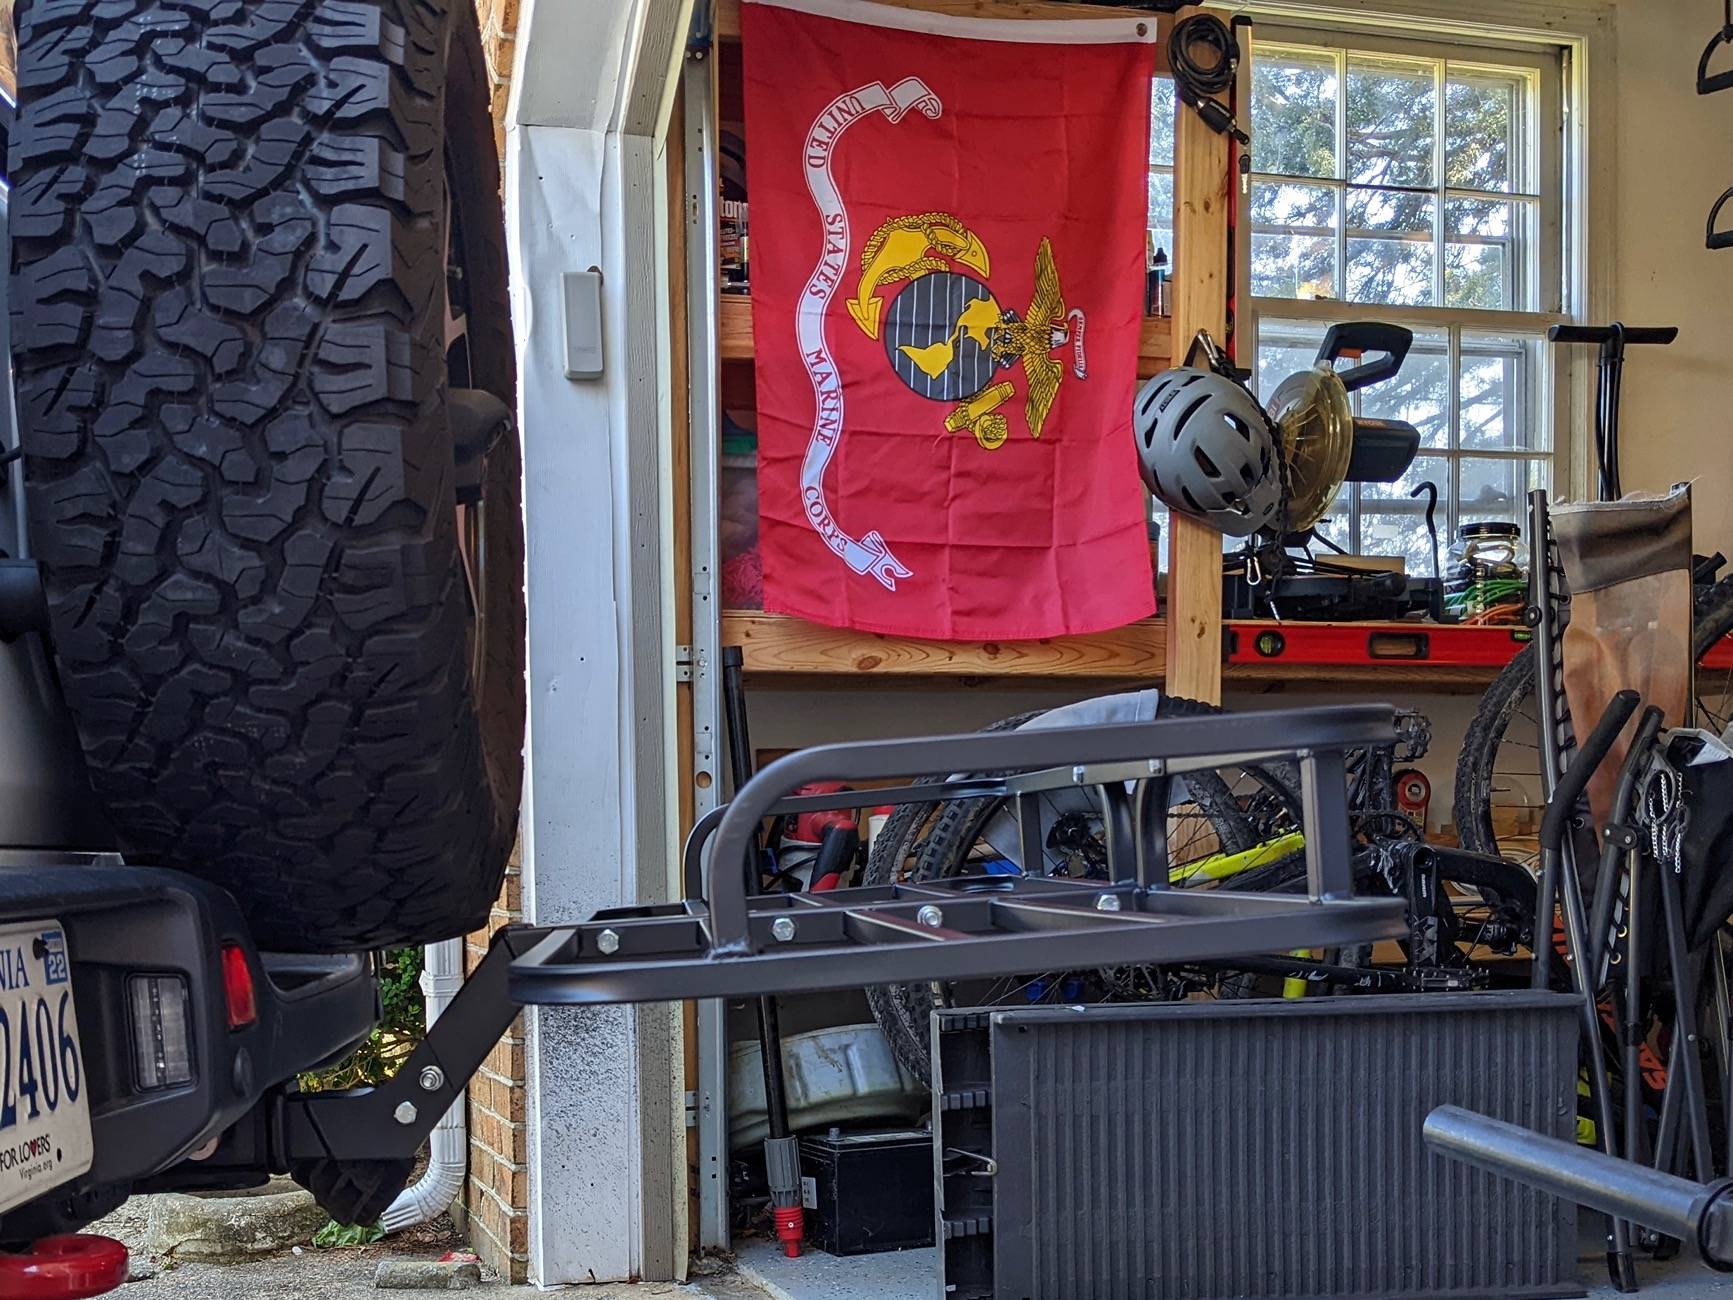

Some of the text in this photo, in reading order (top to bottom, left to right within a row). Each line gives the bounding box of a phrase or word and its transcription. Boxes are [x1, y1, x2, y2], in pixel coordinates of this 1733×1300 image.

[804, 95, 866, 553] UNITED STATES MARINE CORPS
[48, 954, 66, 980] 22
[0, 990, 80, 1128] 2406
[0, 1148, 19, 1172] FOR
